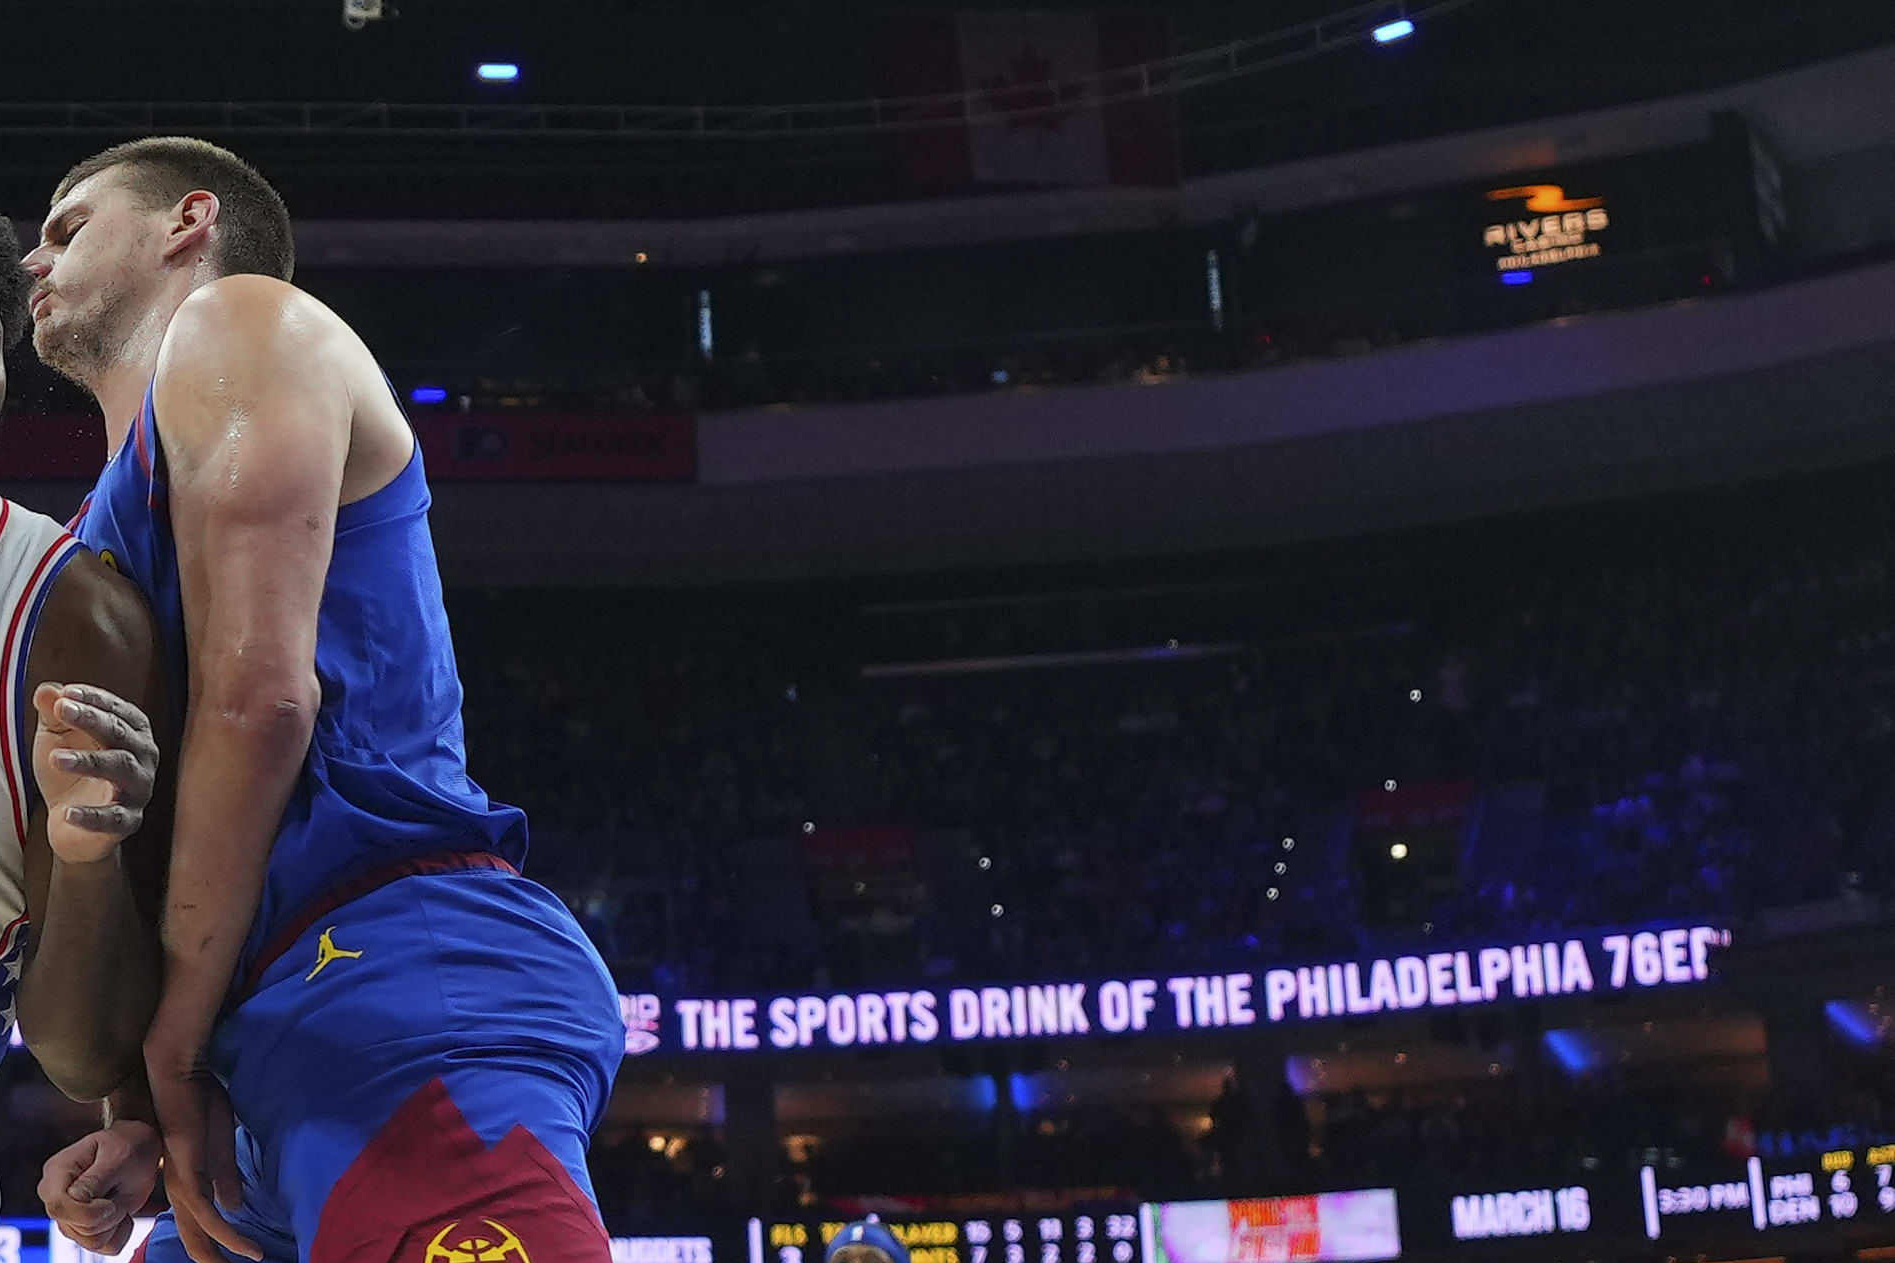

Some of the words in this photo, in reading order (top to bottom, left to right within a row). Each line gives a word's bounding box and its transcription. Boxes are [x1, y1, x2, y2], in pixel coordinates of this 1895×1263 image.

[1485, 208, 1609, 245] RIVERS
[675, 998, 760, 1050] THE
[769, 990, 939, 1049] SPORTS
[949, 983, 1089, 1040] DRINK
[1099, 980, 1157, 1033] OF
[1167, 974, 1255, 1028] THE
[1265, 940, 1594, 1021] PHILADELPHIA
[1452, 1188, 1556, 1238] MARCH
[1556, 1186, 1591, 1232] 16
[1768, 1195, 1821, 1226] DEN
[1828, 1192, 1858, 1219] 10
